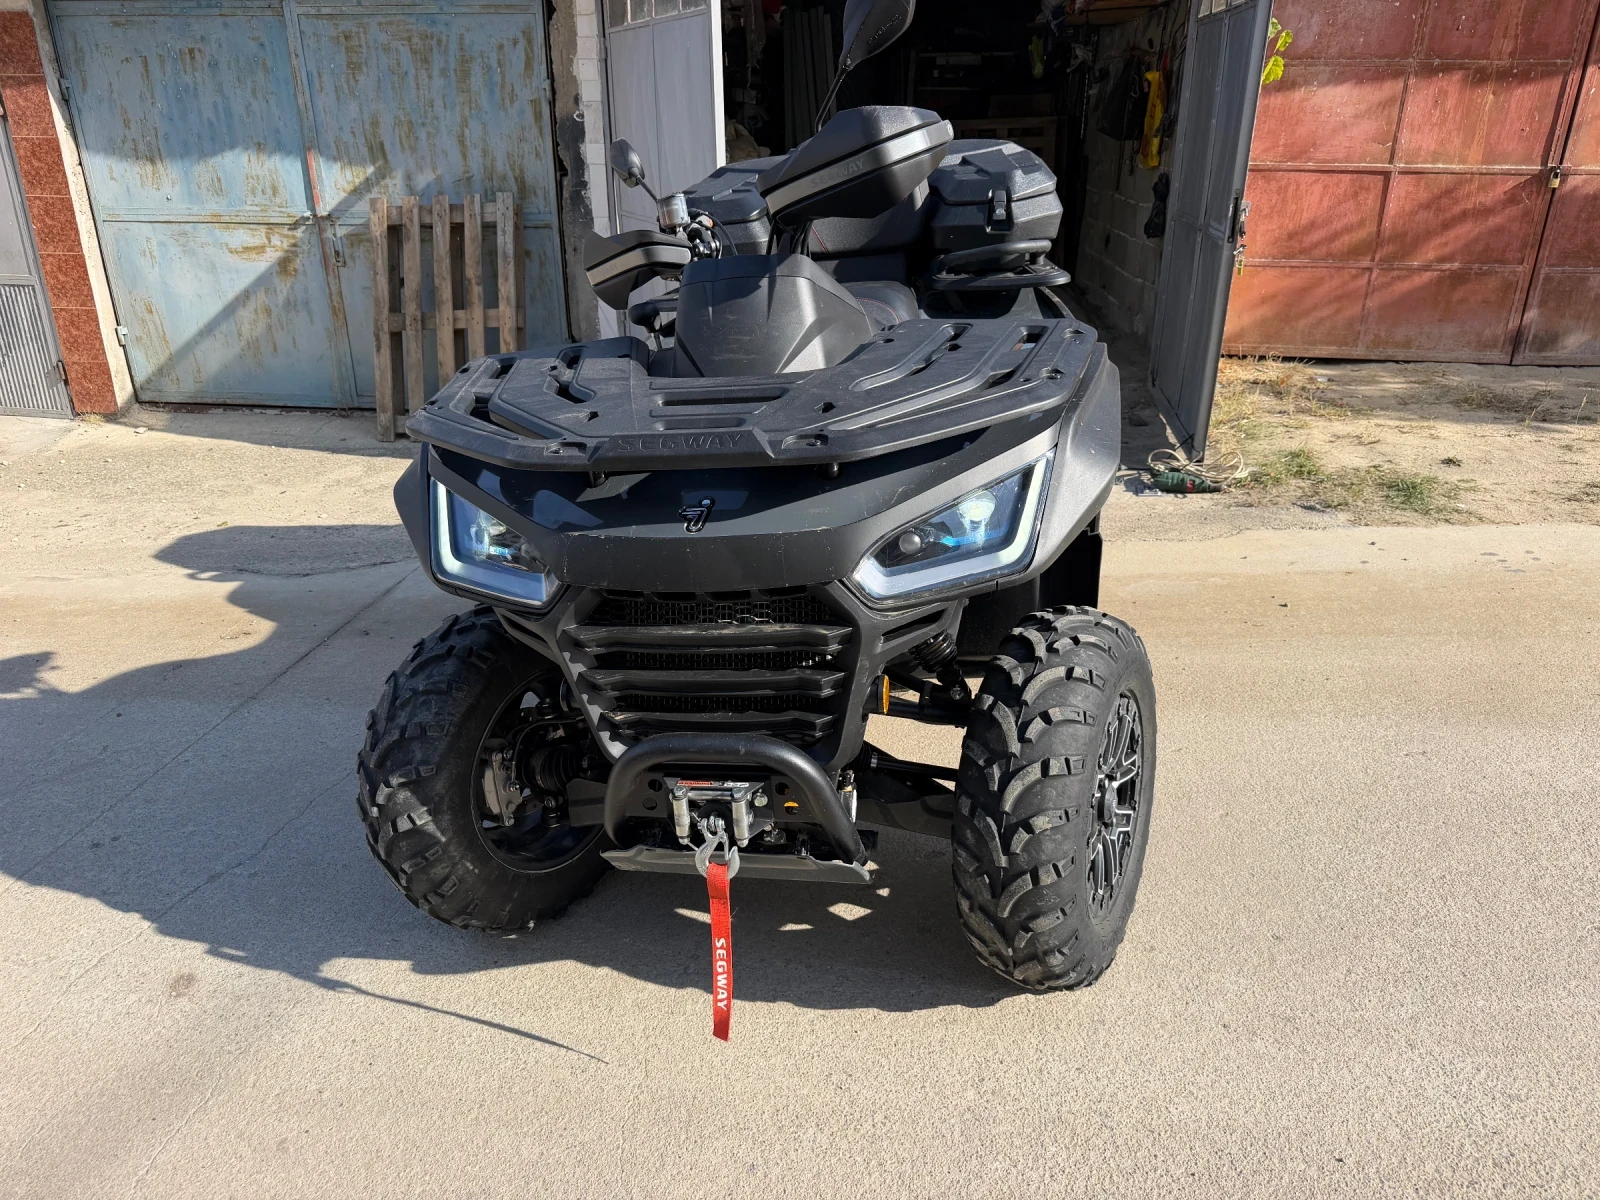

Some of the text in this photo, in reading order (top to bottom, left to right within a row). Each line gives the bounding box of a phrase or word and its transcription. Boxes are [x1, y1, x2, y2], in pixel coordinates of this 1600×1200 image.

[810, 158, 864, 188] SEWAY
[618, 433, 744, 452] SEGWAY
[715, 937, 728, 1011] SEGWAY
